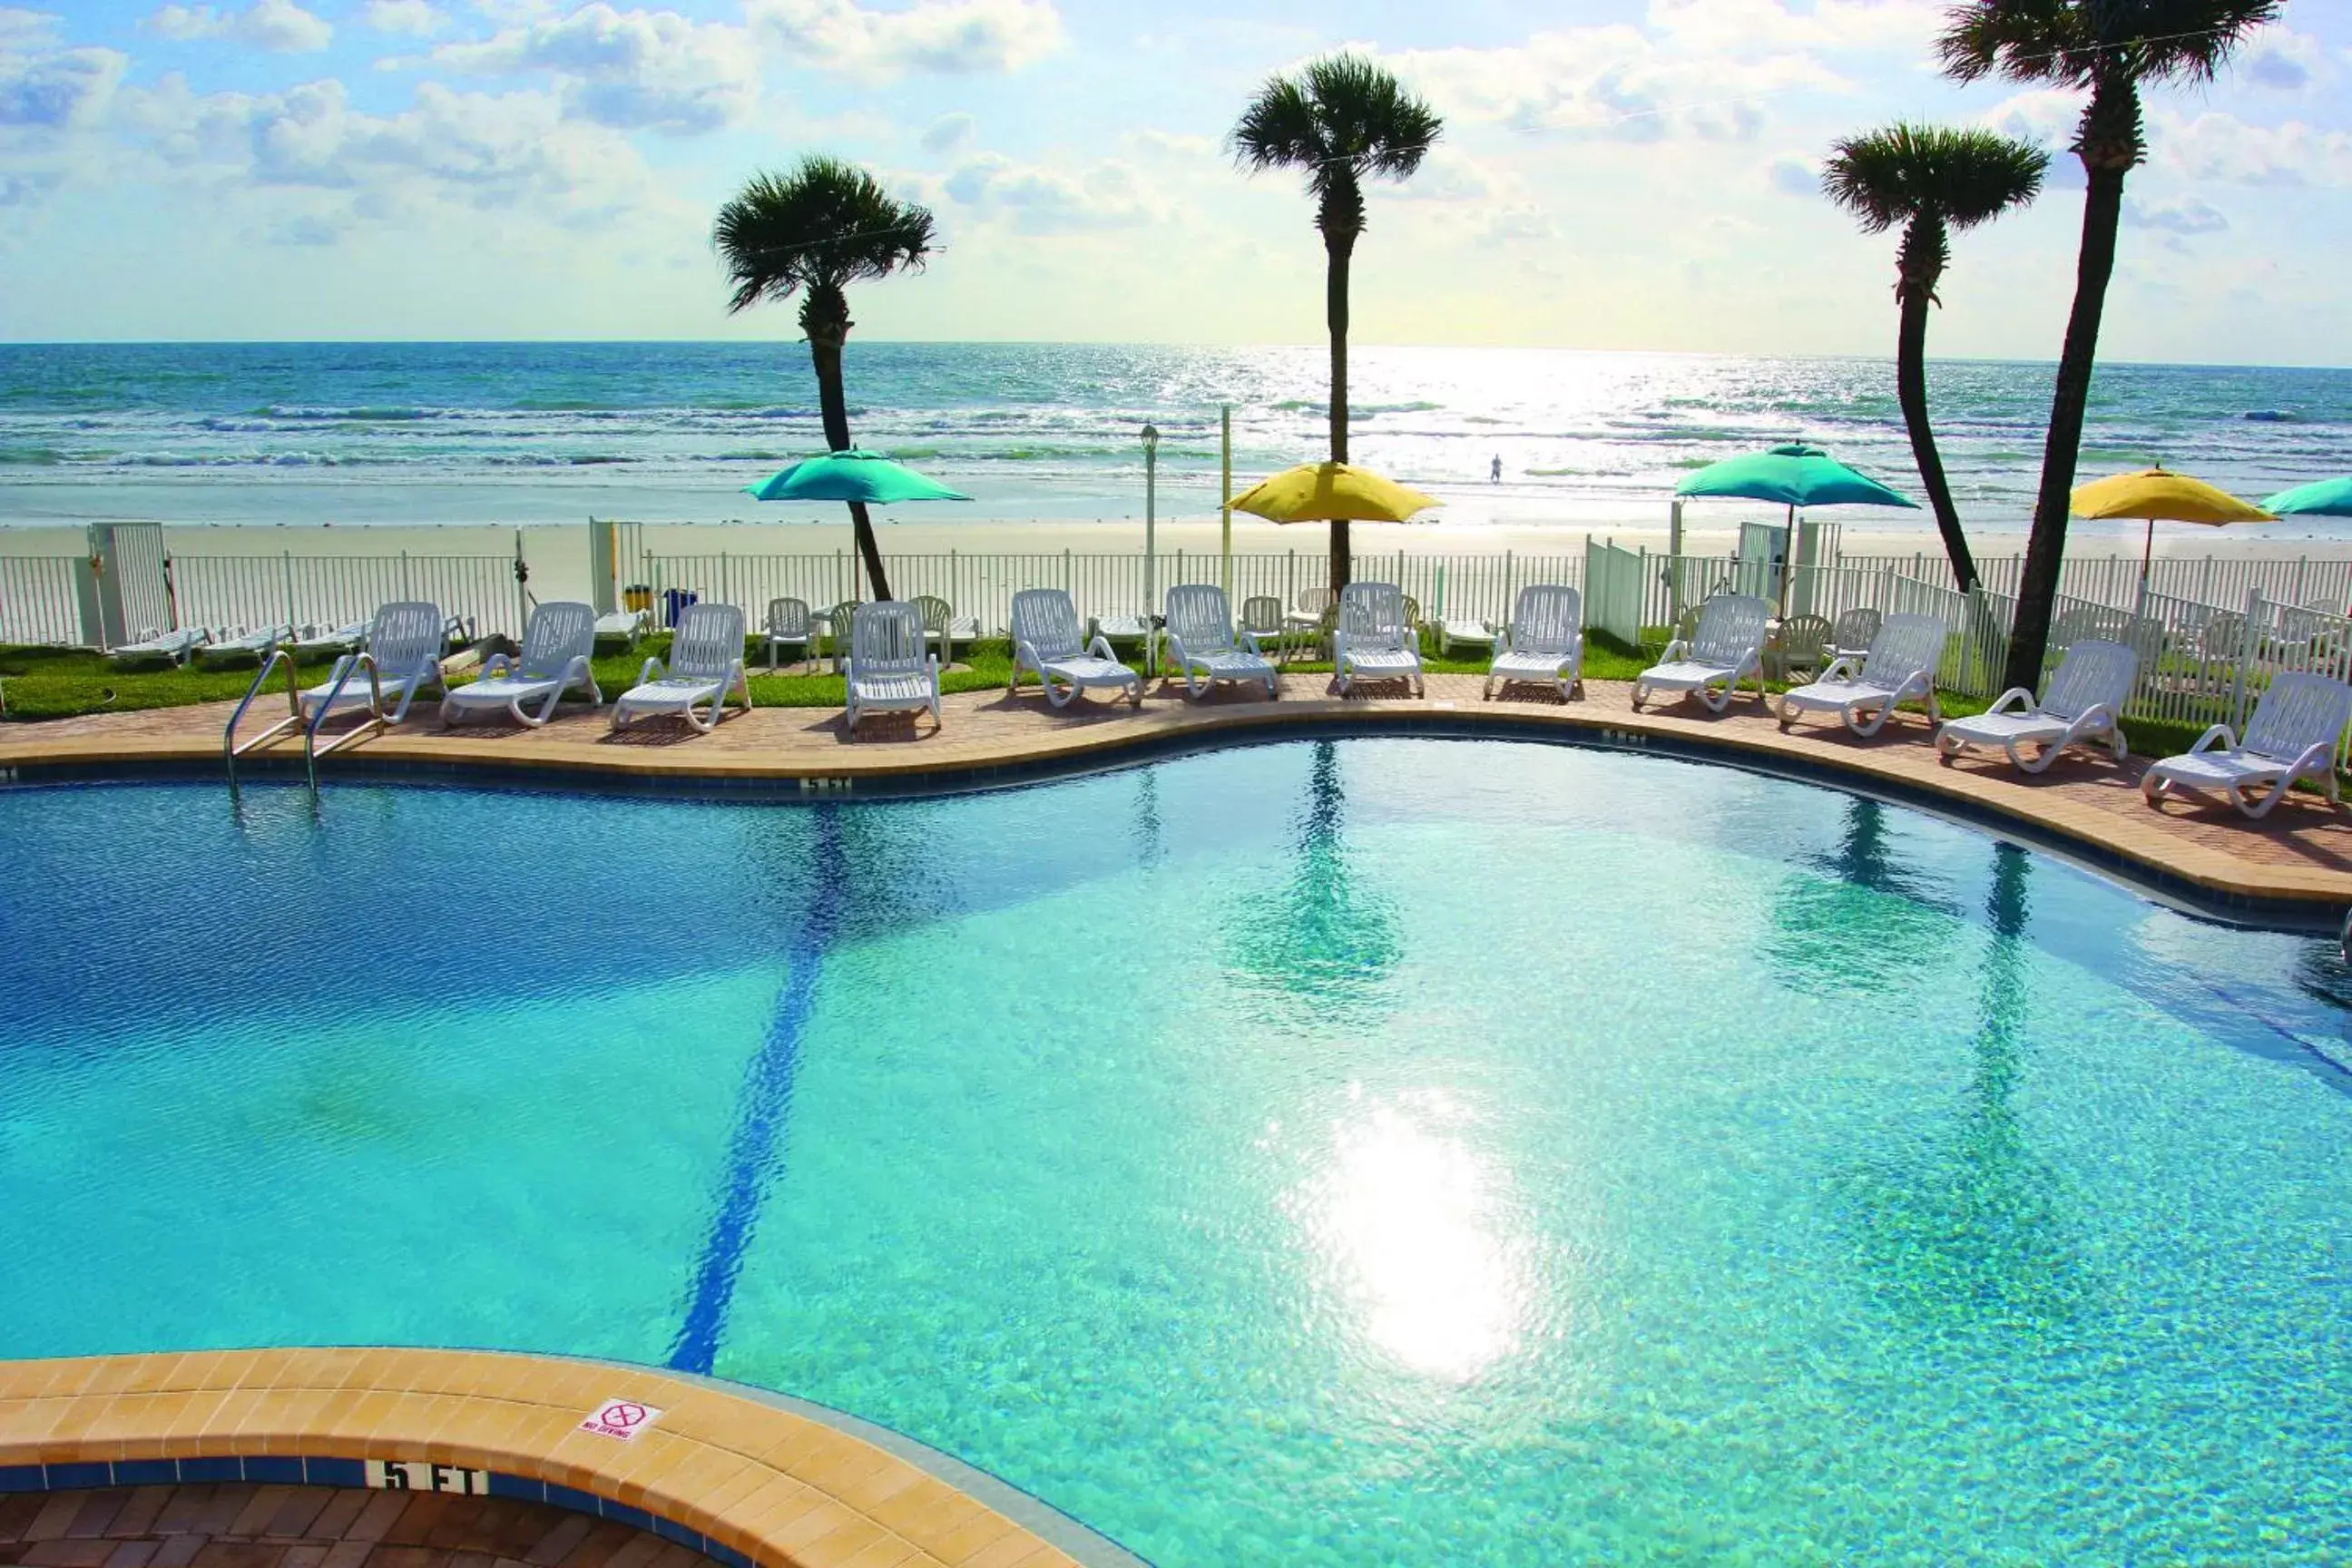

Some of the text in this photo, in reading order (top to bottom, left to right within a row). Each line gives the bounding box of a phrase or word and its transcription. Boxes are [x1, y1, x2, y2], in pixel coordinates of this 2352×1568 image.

[808, 777, 849, 790] 5 FT
[599, 1425, 632, 1438] DIVING
[384, 1461, 479, 1495] 5 FT
